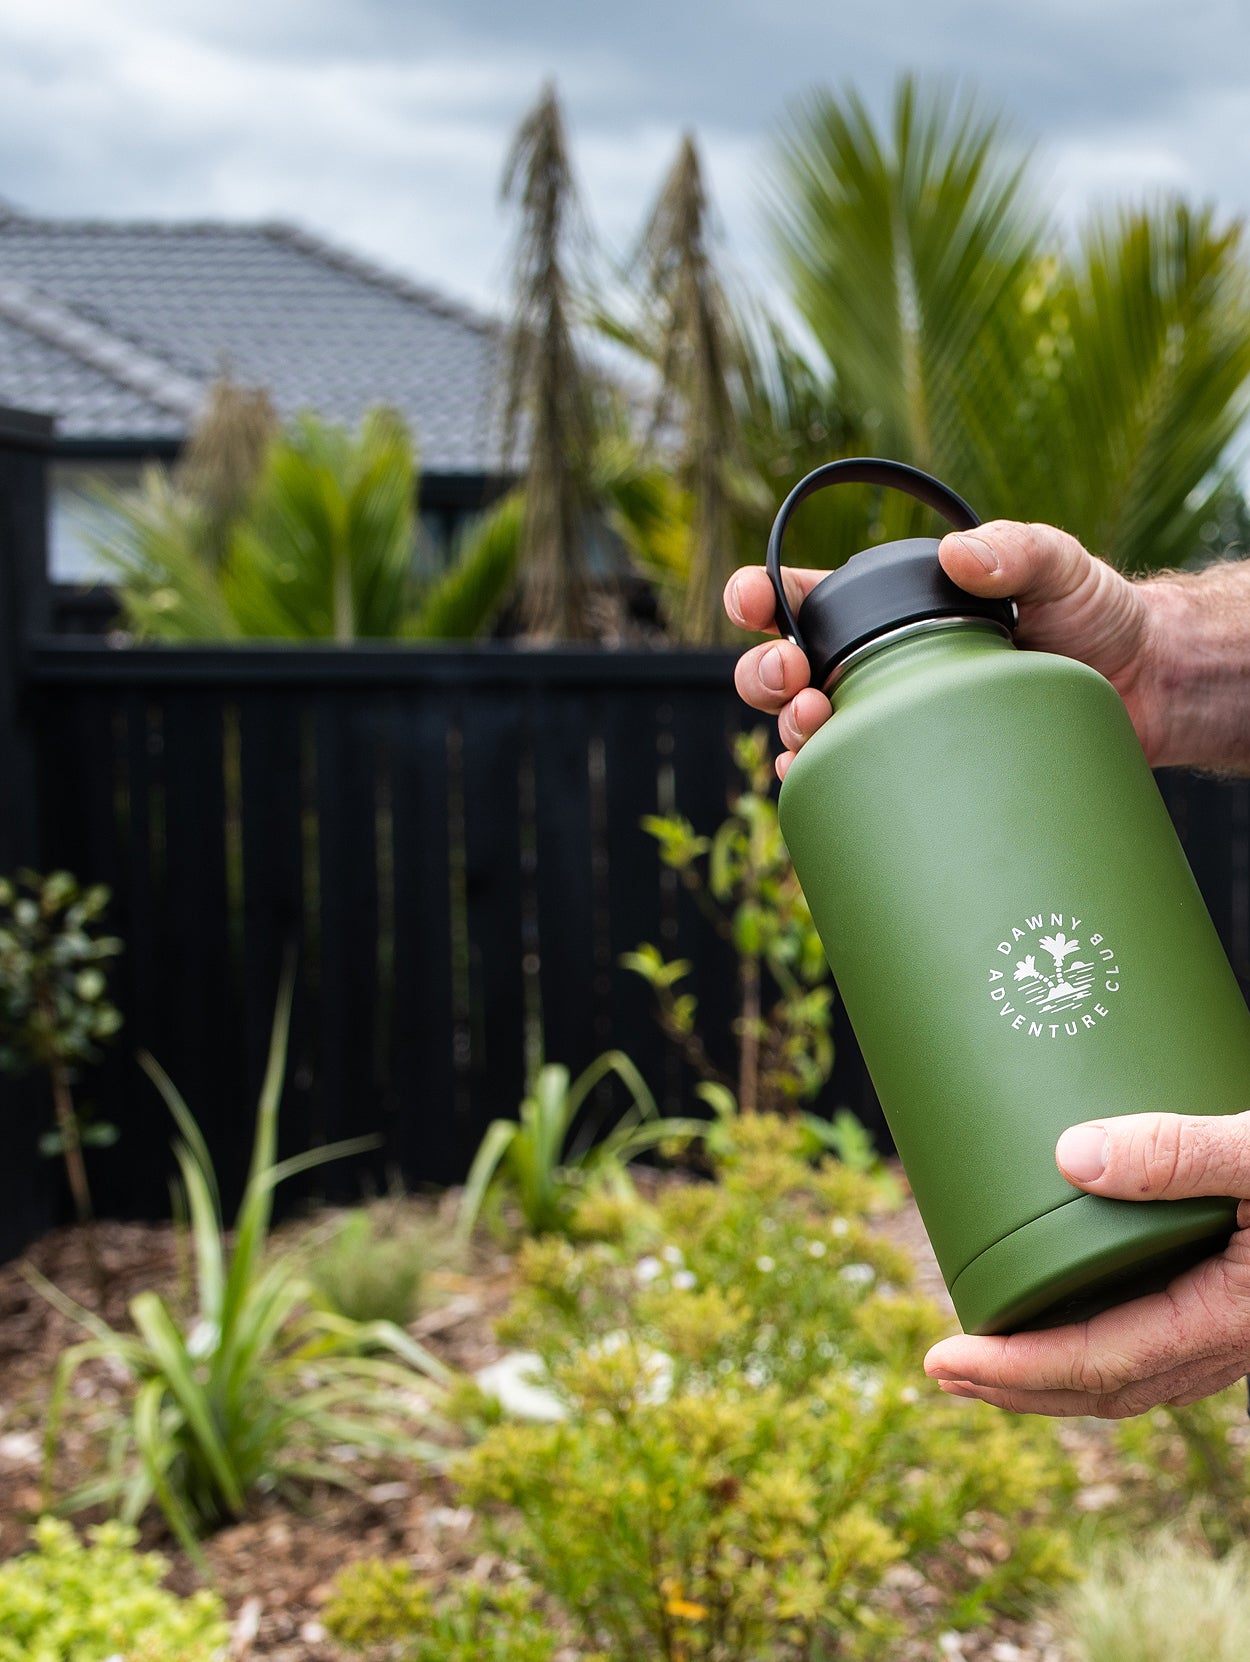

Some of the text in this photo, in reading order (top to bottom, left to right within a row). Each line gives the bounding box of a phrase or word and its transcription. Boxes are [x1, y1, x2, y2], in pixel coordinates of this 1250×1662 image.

[996, 913, 1082, 956] DAWNY
[988, 933, 1120, 1038] ADVENTURE CLUB
